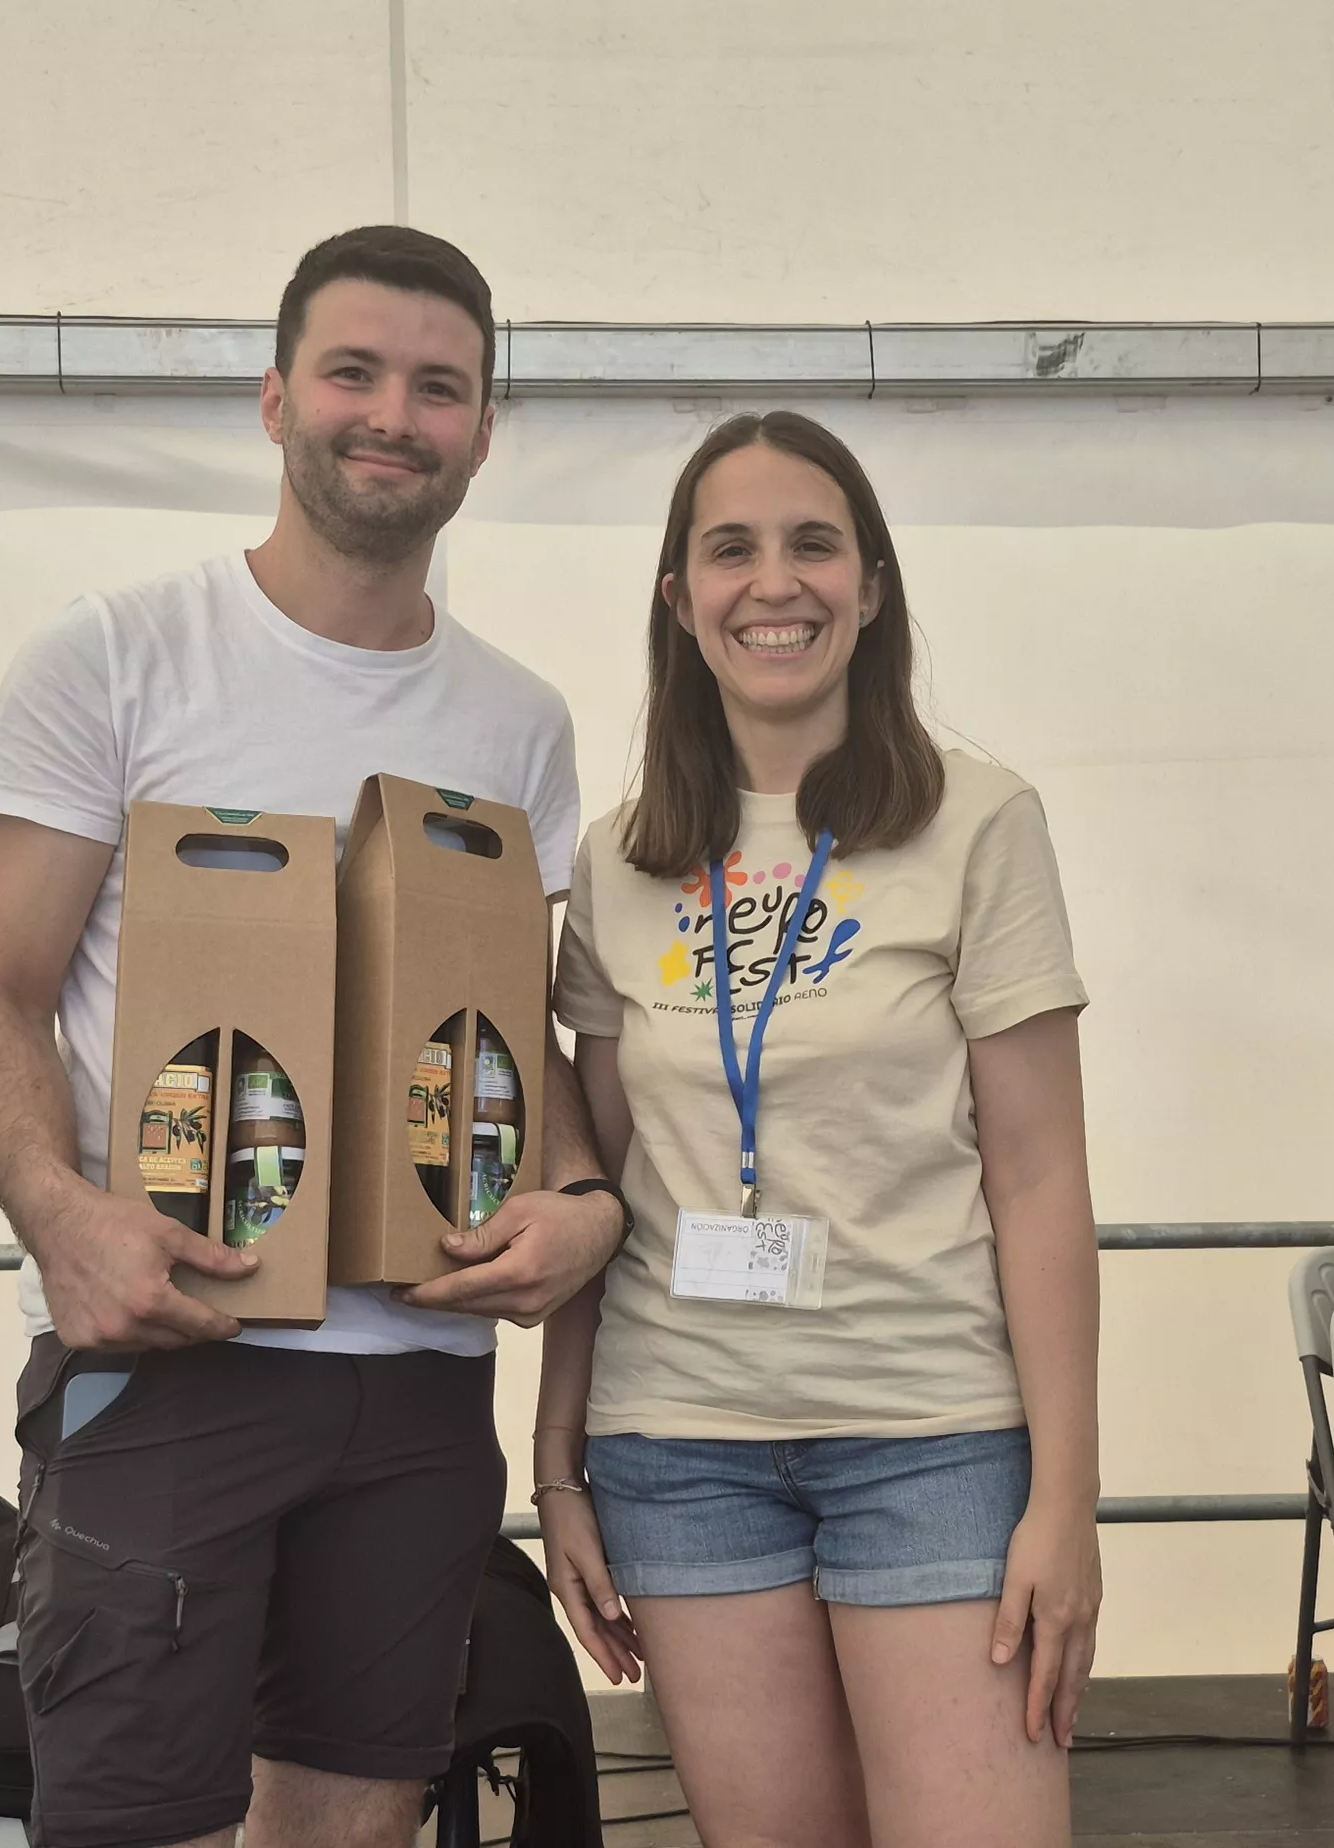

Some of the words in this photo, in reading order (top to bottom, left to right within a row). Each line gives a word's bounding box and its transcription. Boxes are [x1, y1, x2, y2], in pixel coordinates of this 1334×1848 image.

[652, 1002, 668, 1011] III
[671, 1005, 719, 1015] FESTIVA
[64, 1525, 110, 1551] Quechua
